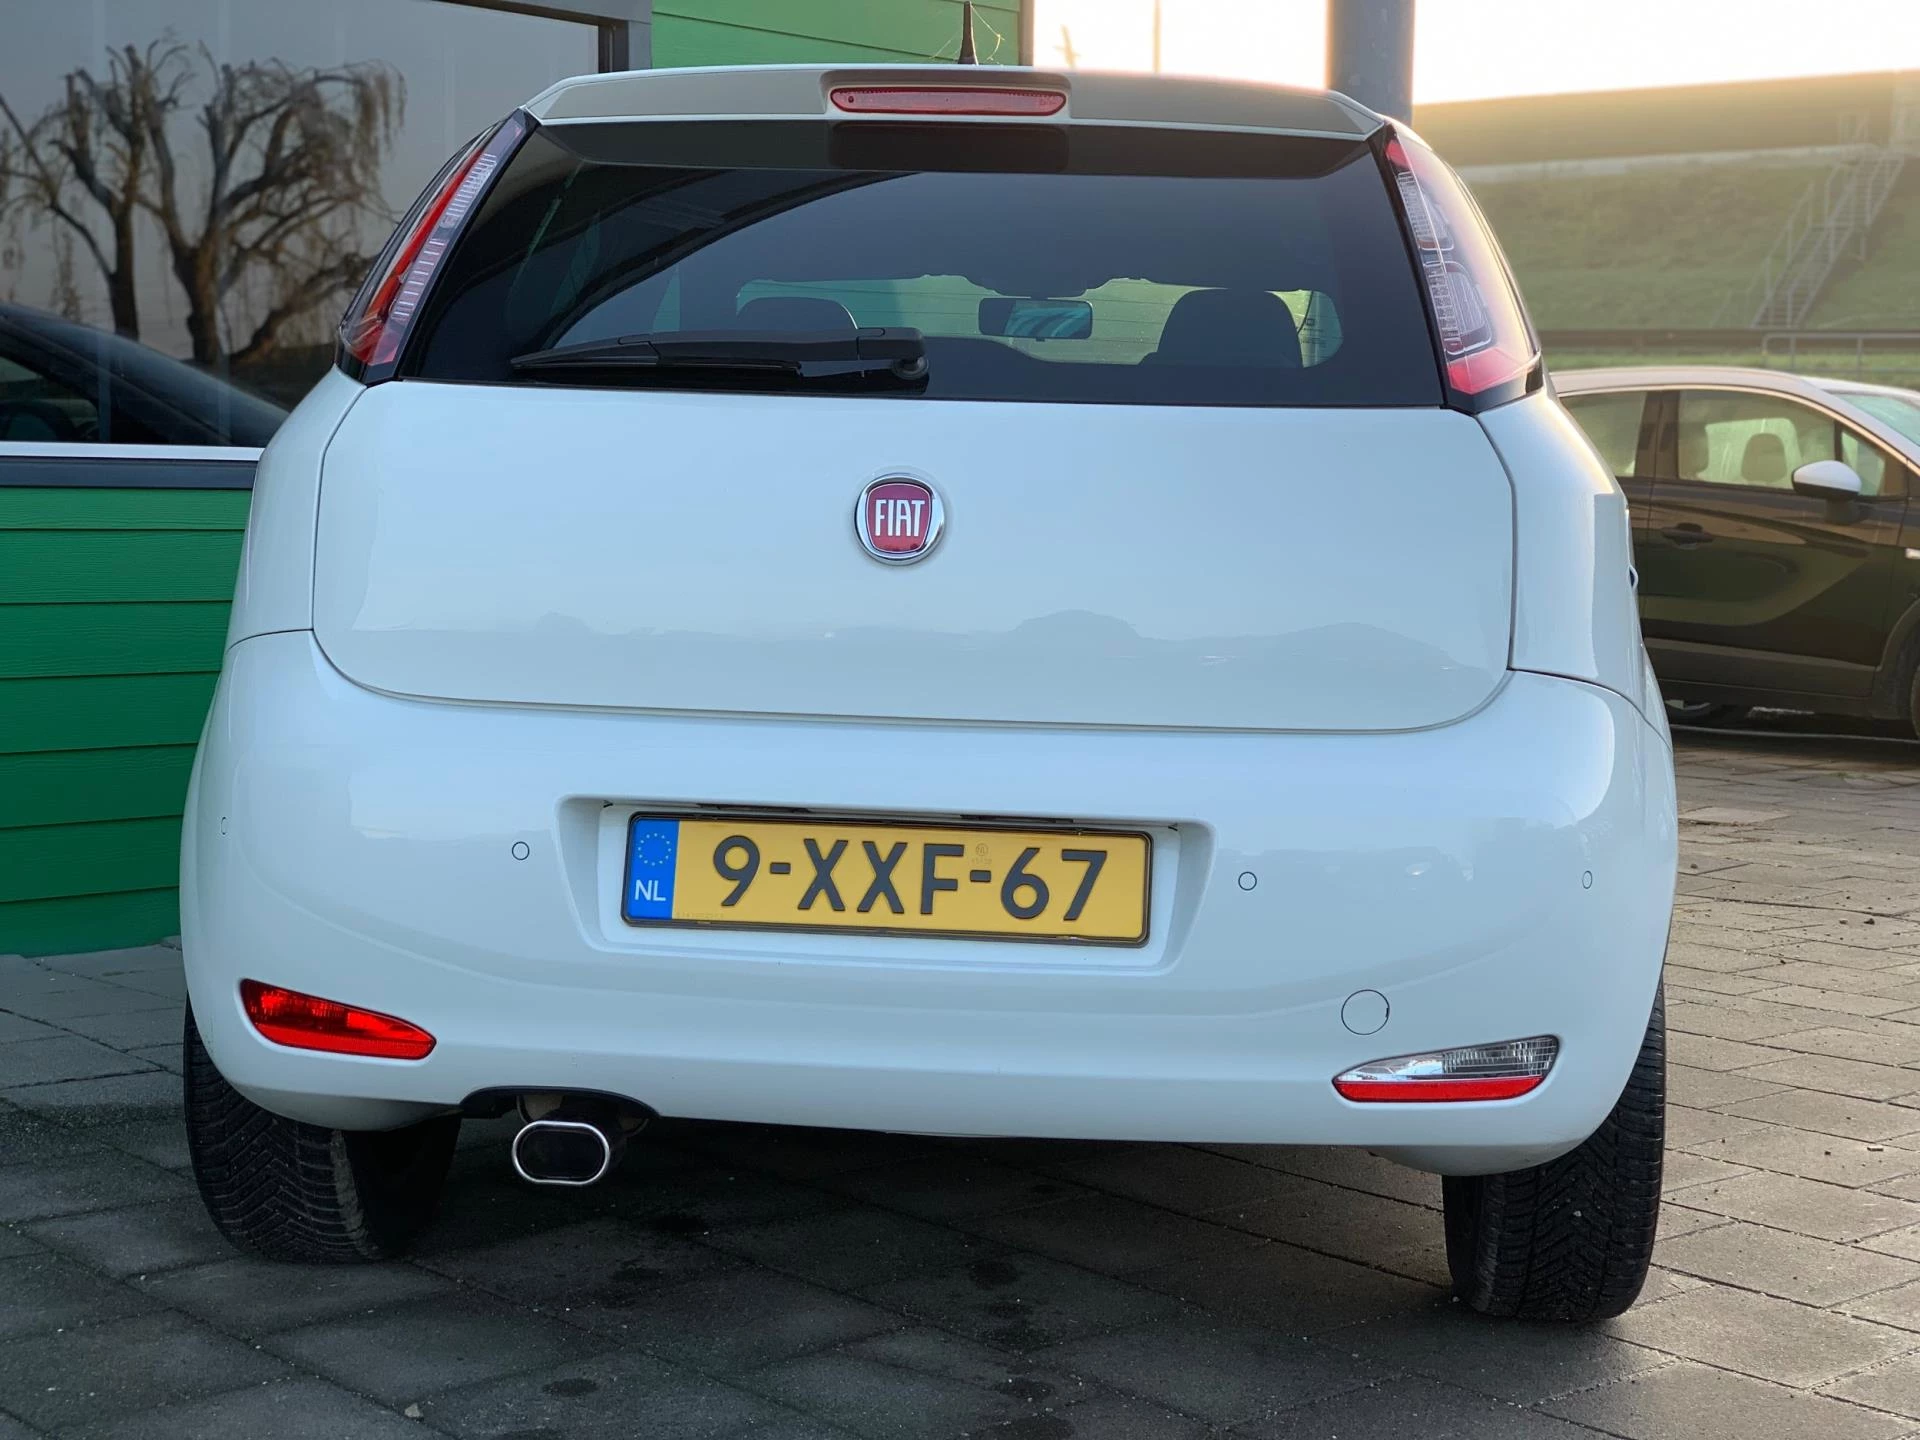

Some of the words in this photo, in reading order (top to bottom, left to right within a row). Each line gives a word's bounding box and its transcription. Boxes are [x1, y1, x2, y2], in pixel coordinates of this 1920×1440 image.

[875, 499, 925, 536] FIAT
[634, 879, 666, 902] NL
[712, 834, 1108, 921] 9-XXF-67
